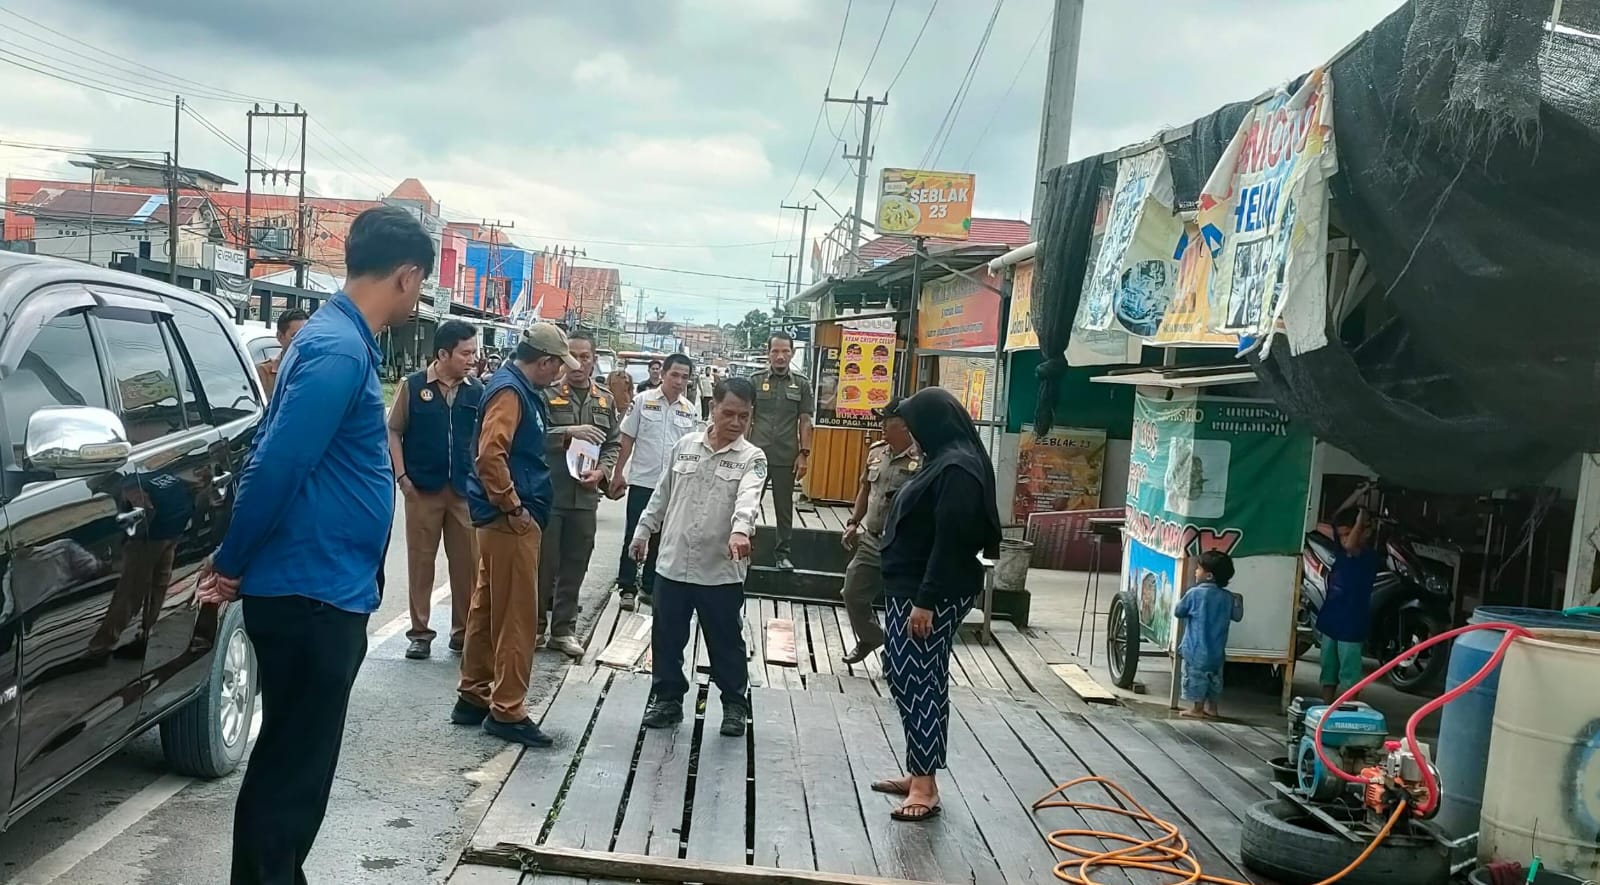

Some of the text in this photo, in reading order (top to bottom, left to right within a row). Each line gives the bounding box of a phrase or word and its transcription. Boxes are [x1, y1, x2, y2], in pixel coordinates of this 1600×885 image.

[909, 188, 969, 204] SEBLAK
[928, 204, 948, 219] 23
[860, 336, 878, 345] CRISPY
[879, 337, 895, 346] CELUP
[1211, 420, 1288, 437] Menerima
[1034, 436, 1077, 448] SEBLAK
